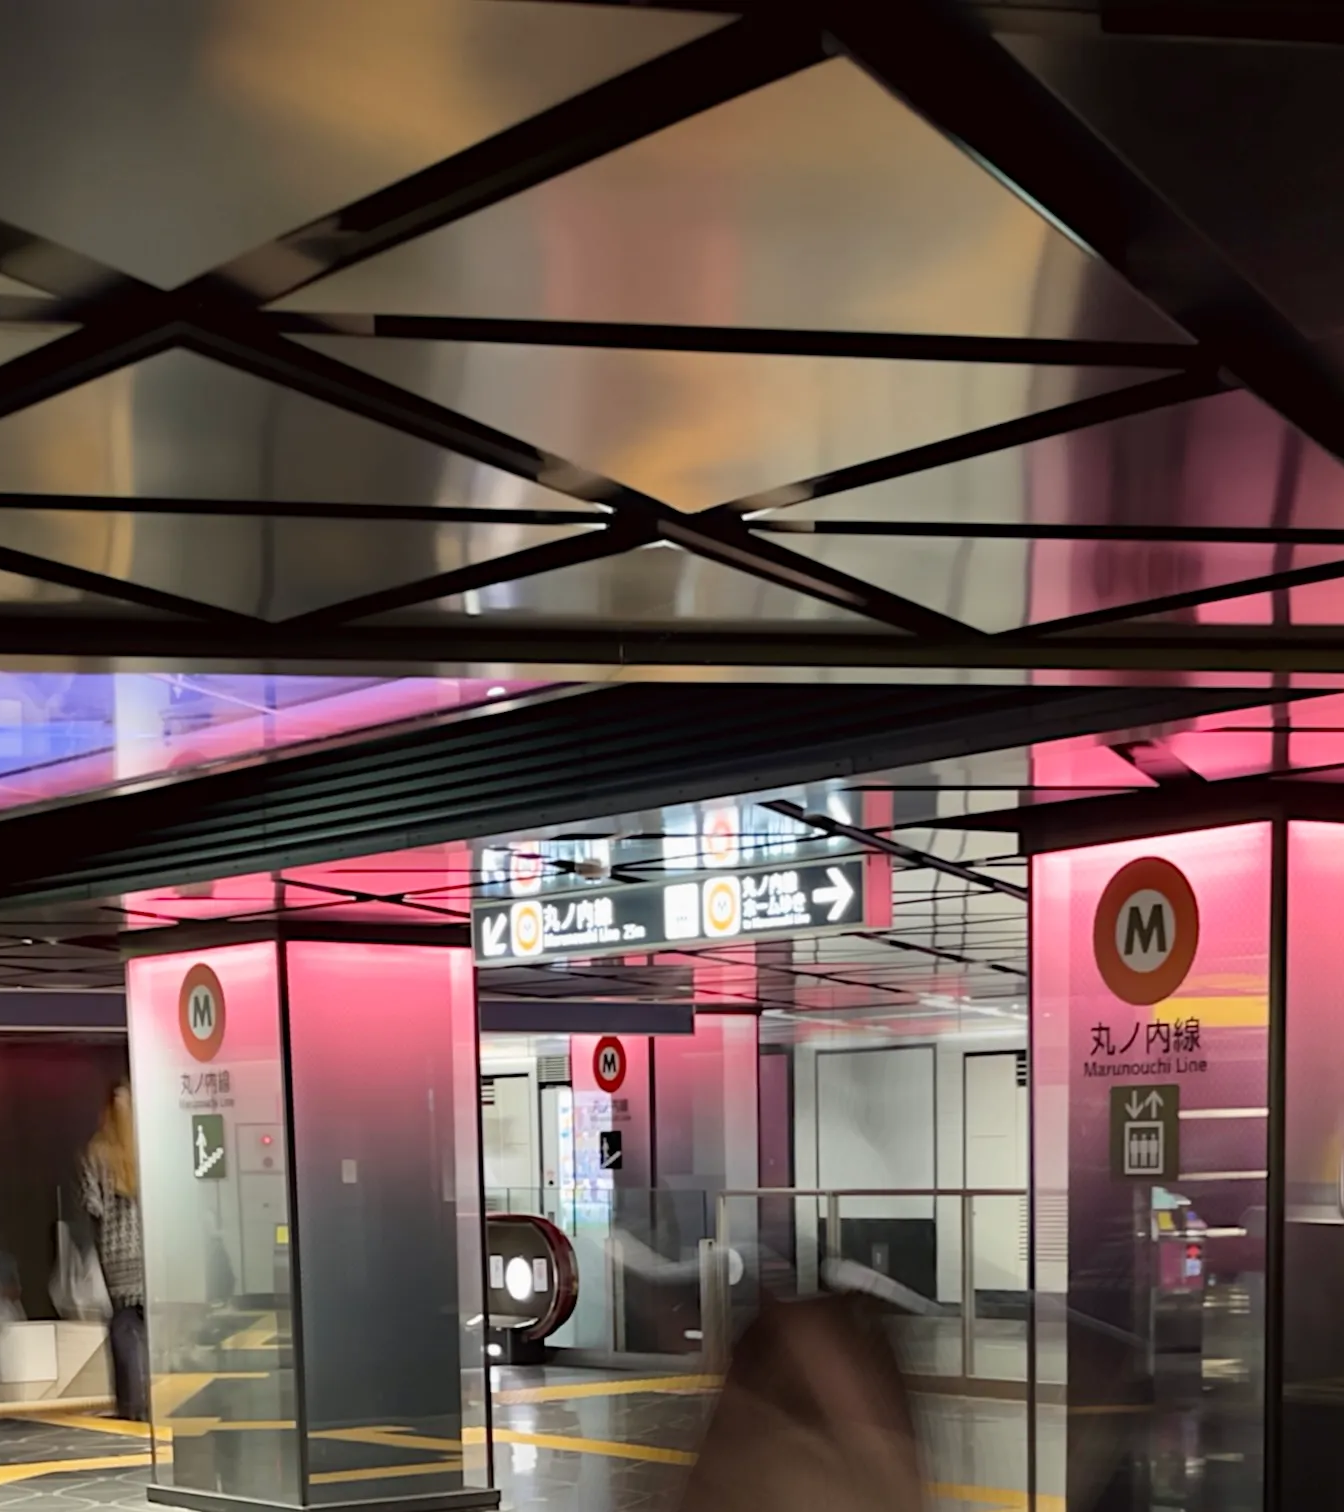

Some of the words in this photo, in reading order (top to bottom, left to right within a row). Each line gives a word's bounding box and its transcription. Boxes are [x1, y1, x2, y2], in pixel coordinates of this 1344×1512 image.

[1123, 904, 1167, 956] M
[193, 994, 212, 1028] M
[1090, 1017, 1201, 1056] 丸ノ内線
[602, 1053, 616, 1073] M
[1083, 1059, 1171, 1077] Marunouchi
[1175, 1057, 1207, 1074] Line
[181, 1070, 231, 1095] 丸ノ内線
